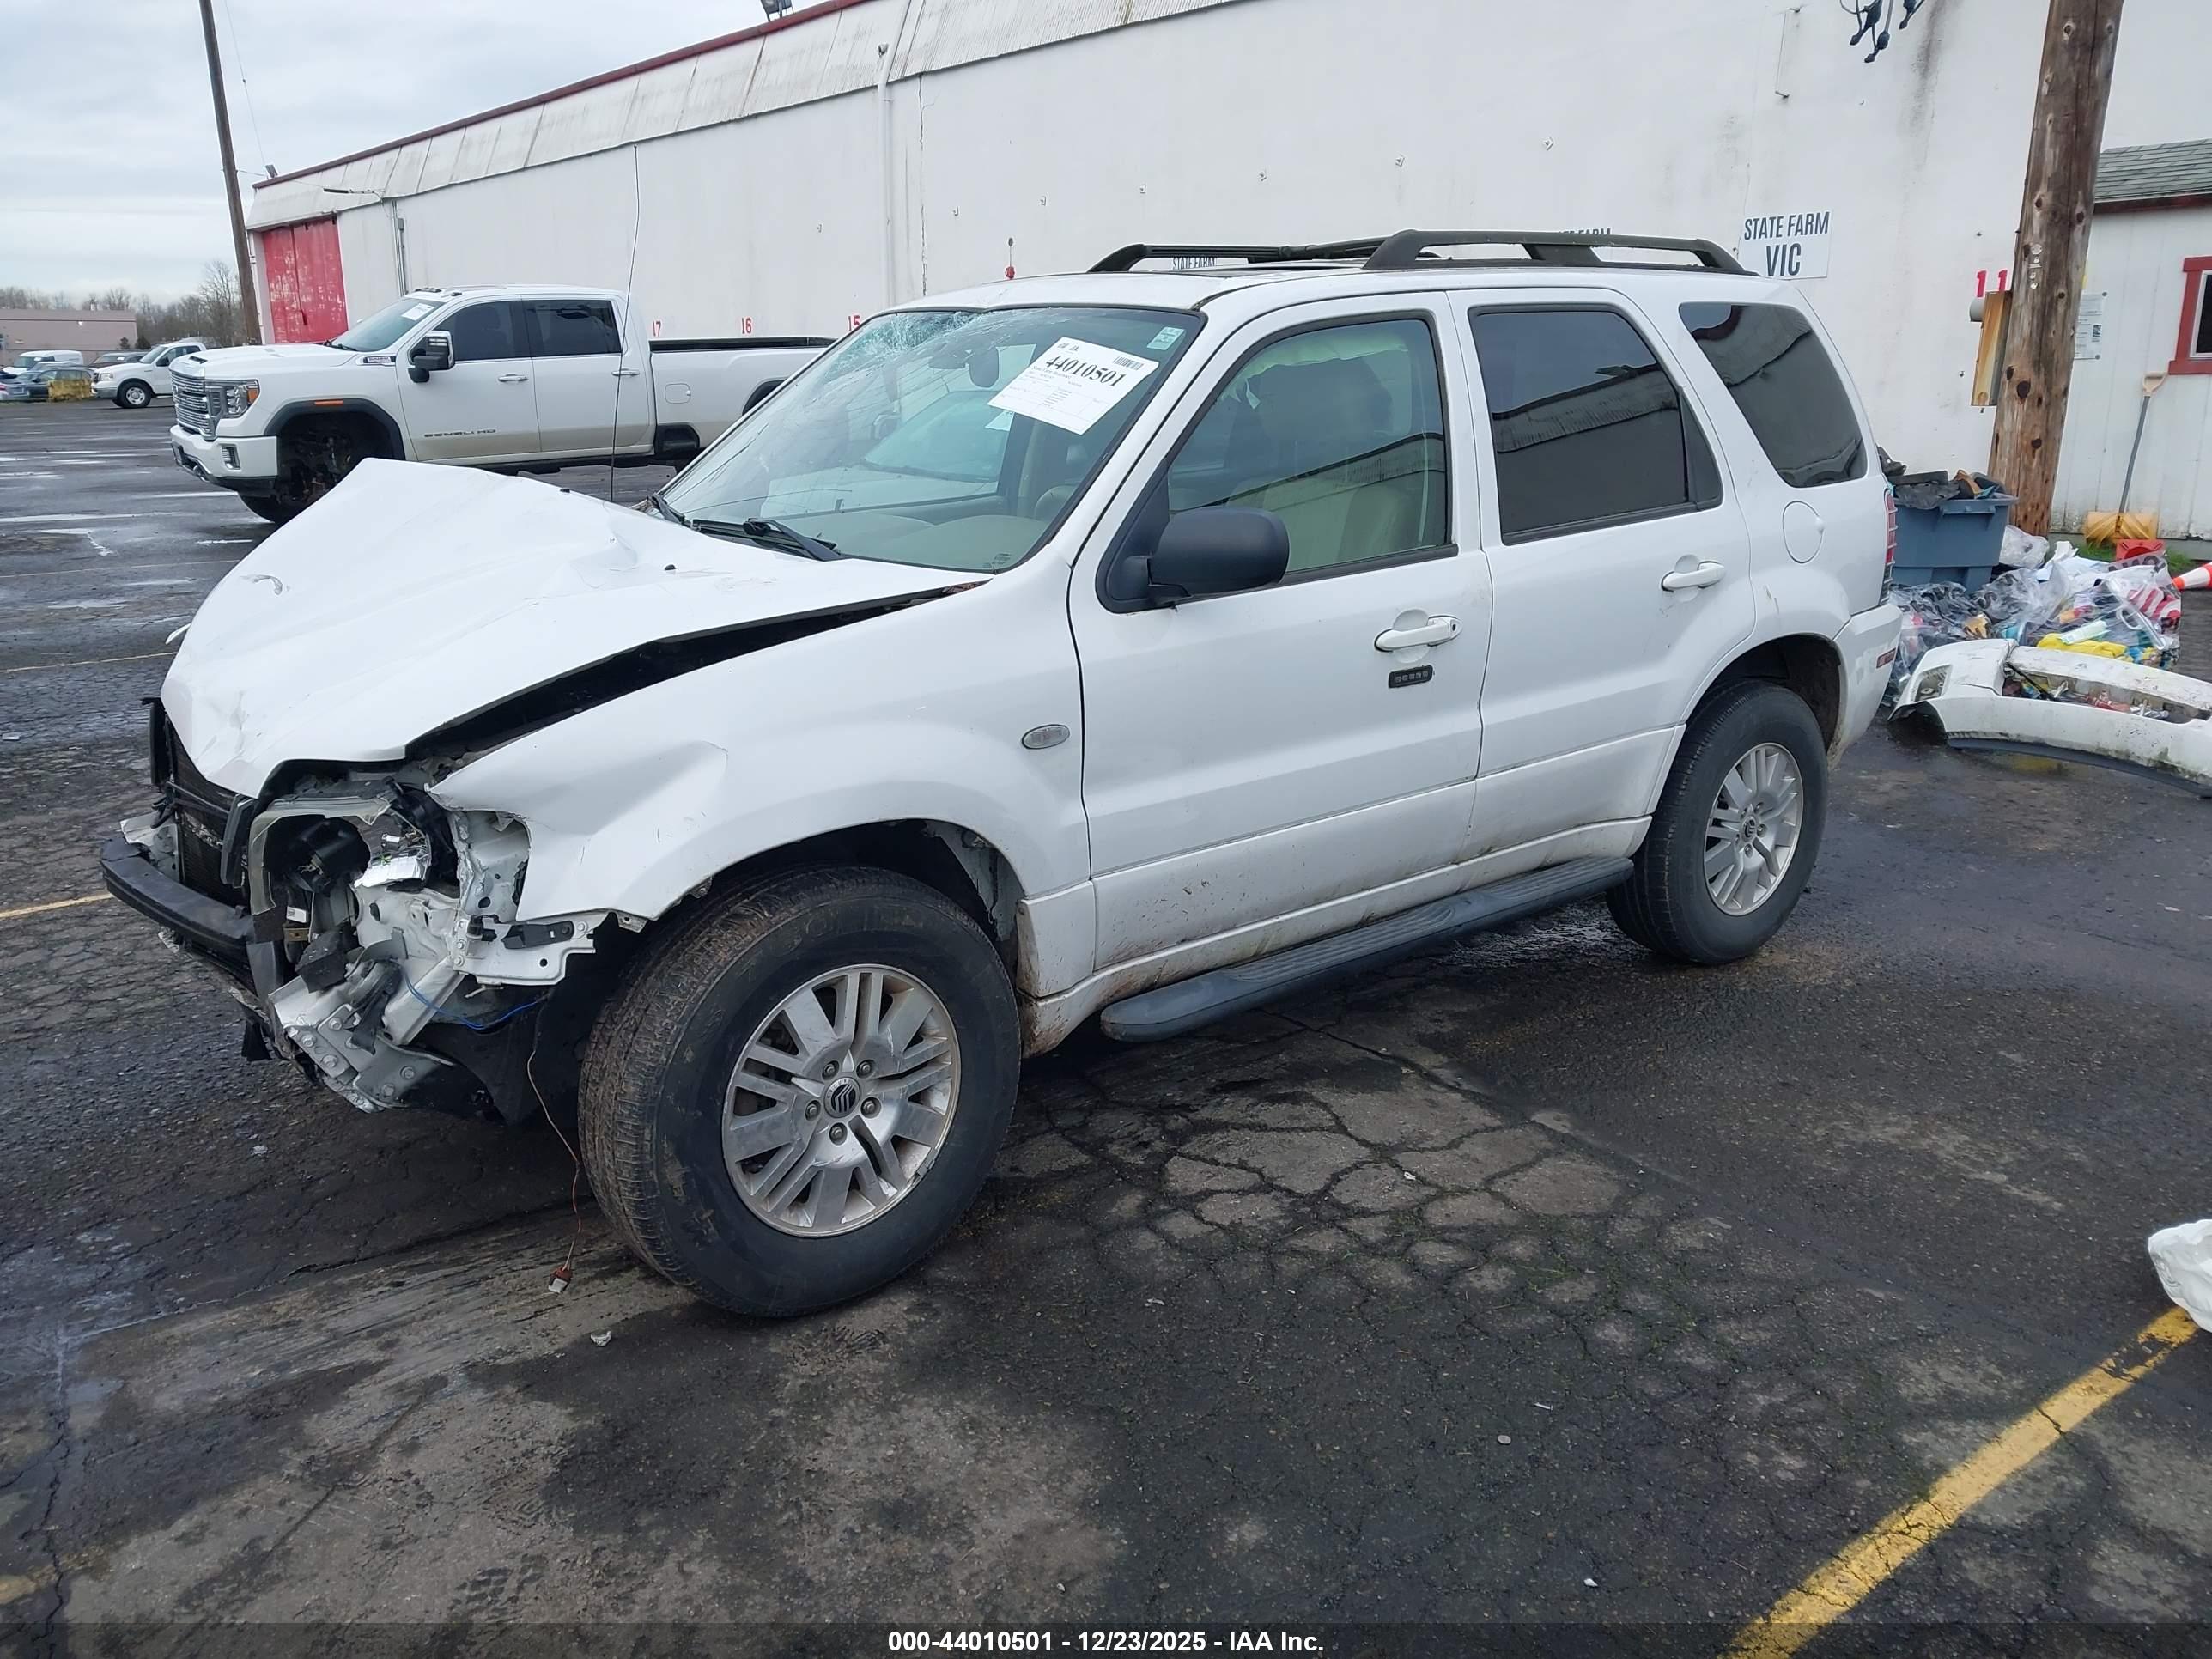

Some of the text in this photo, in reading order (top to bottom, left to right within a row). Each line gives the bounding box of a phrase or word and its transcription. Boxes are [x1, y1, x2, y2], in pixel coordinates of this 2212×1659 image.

[1744, 211, 1830, 240] STATE FARM
[1765, 242, 1802, 277] VIC
[652, 320, 662, 337] 17
[741, 317, 753, 335] 16
[1045, 354, 1127, 387] 44010501
